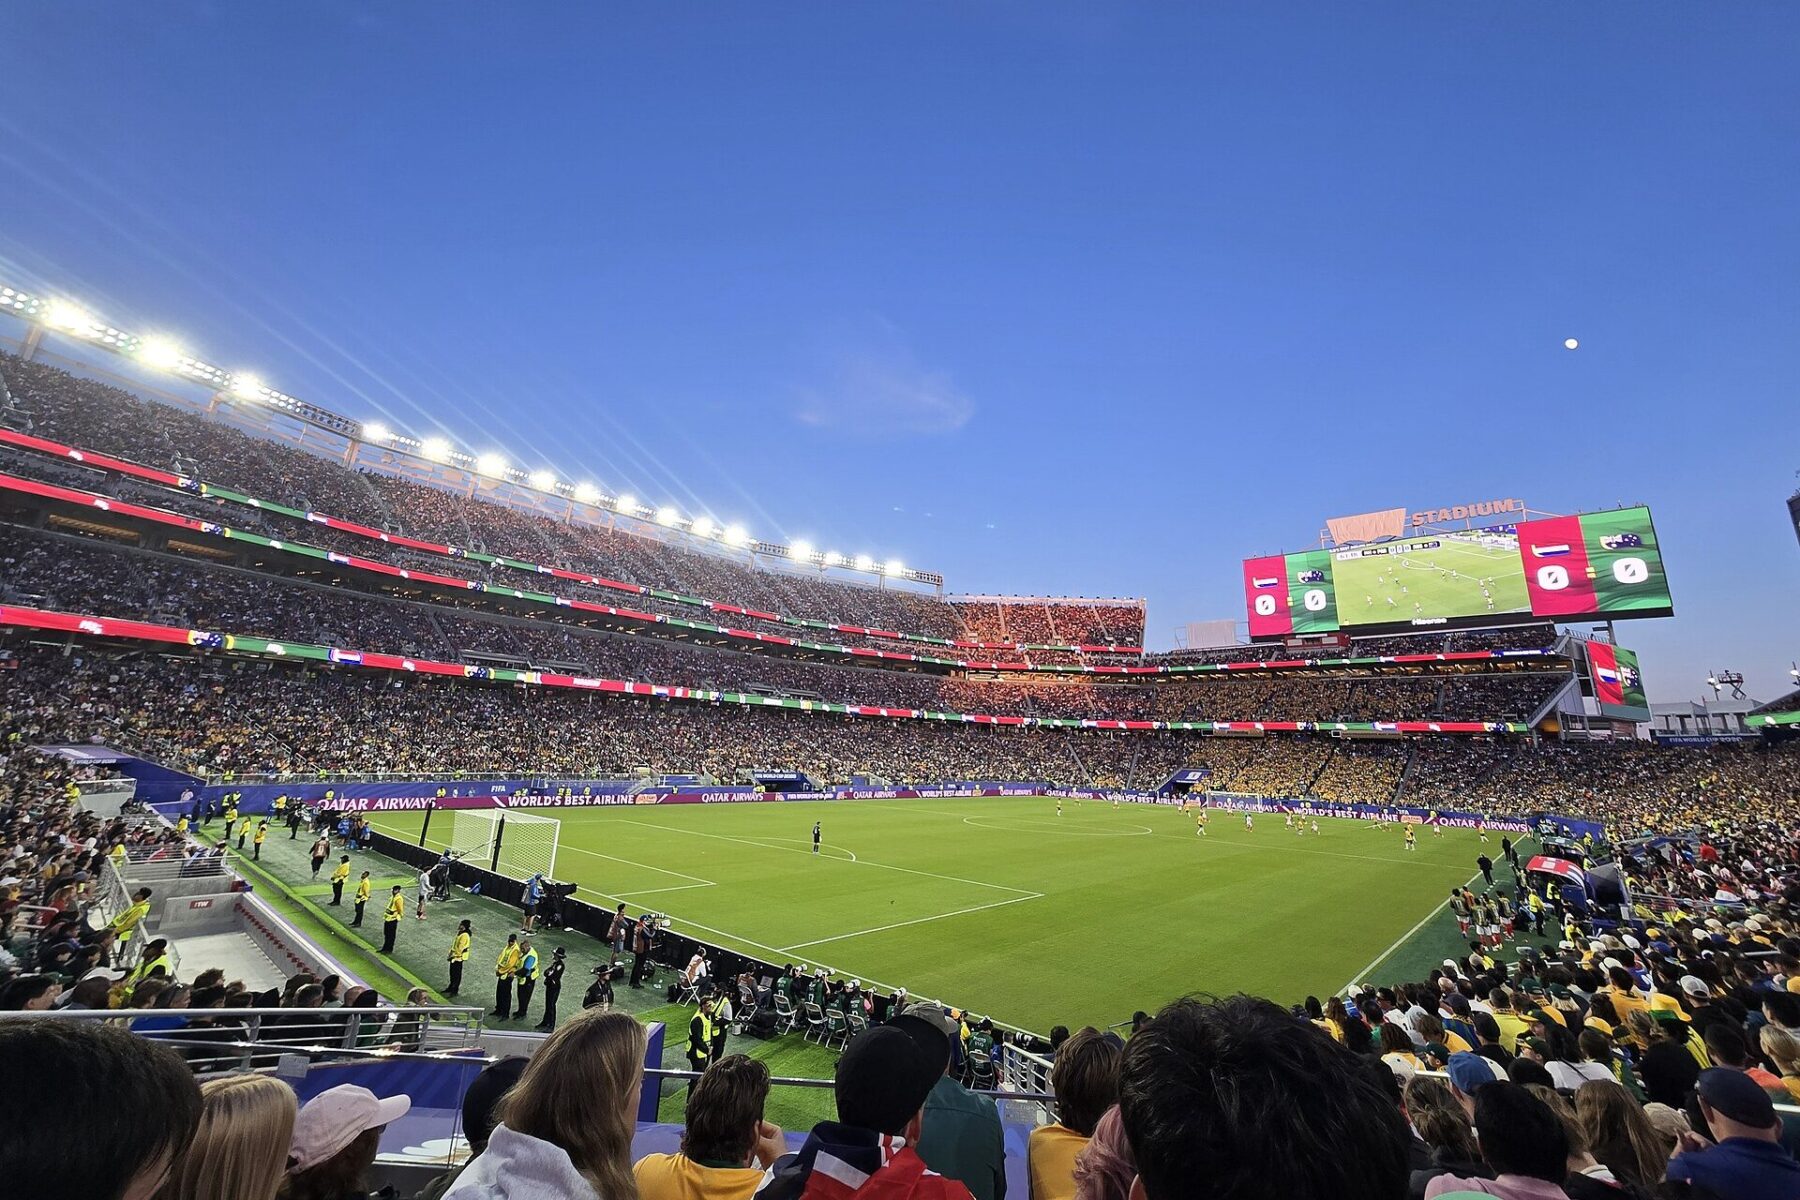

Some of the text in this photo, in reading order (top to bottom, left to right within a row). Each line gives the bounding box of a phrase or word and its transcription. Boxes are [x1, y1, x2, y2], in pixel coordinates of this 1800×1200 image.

[1411, 498, 1515, 527] STADIUM
[490, 785, 506, 793] FIFA
[853, 790, 897, 799] QATAR AIRWAYS
[1046, 789, 1094, 800] QATAR AIRWAYS
[317, 797, 437, 811] QATAR AIRWAYS
[507, 795, 562, 807] WORLD'S
[564, 795, 591, 806] BEST
[592, 794, 635, 805] AIRLINE
[701, 792, 764, 803] QATAR AIRWAYS
[1293, 806, 1333, 817] WORLD'S
[1335, 810, 1358, 819] BEST
[1439, 816, 1528, 833] QATAR AIRWAYS
